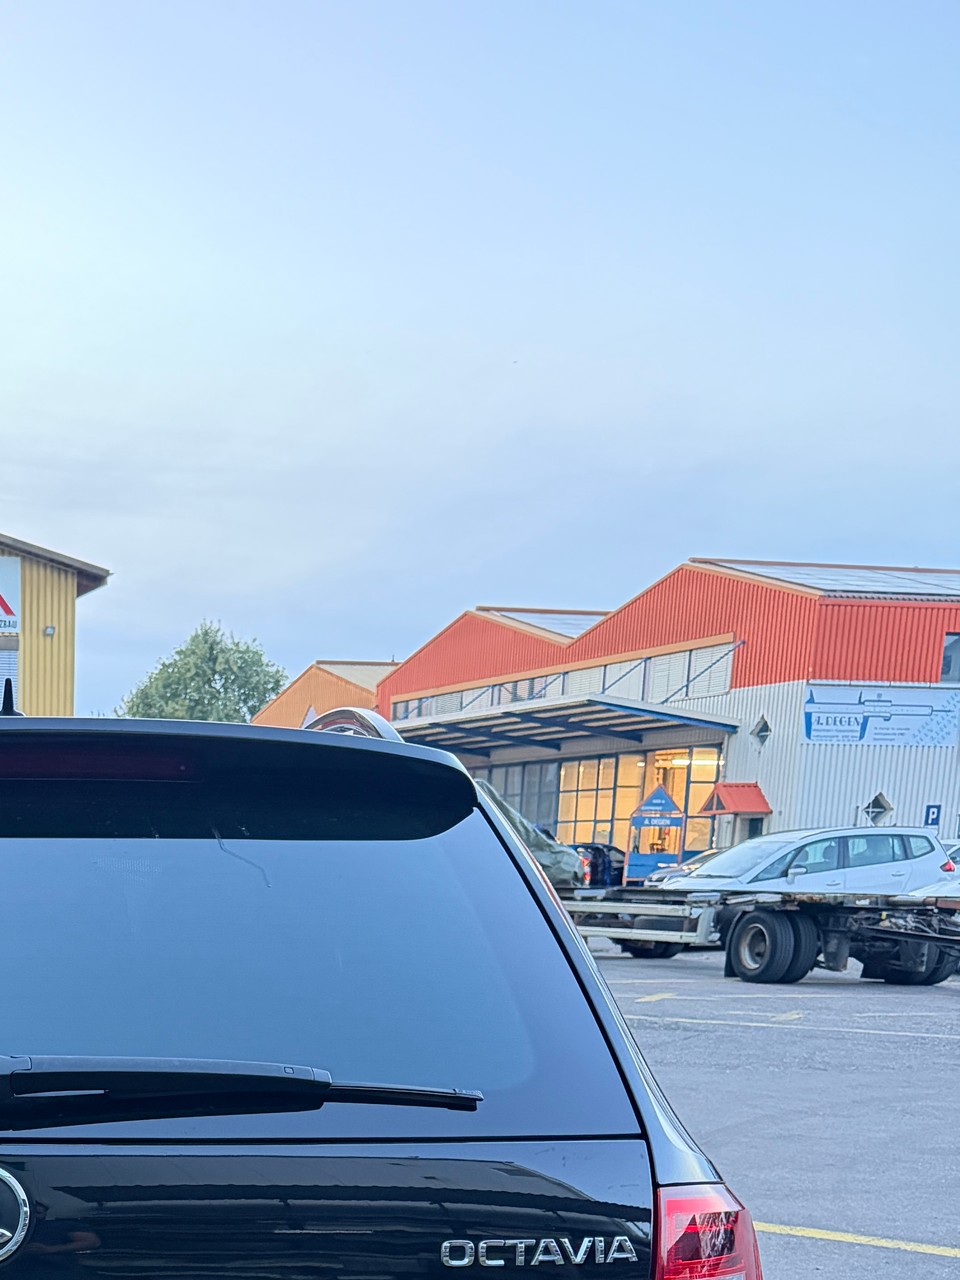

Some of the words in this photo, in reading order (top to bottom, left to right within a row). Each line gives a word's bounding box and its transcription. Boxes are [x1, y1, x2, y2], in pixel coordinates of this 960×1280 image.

[825, 715, 861, 727] DEGEN
[928, 807, 938, 824] P
[440, 1235, 639, 1268] OCTAVIA
